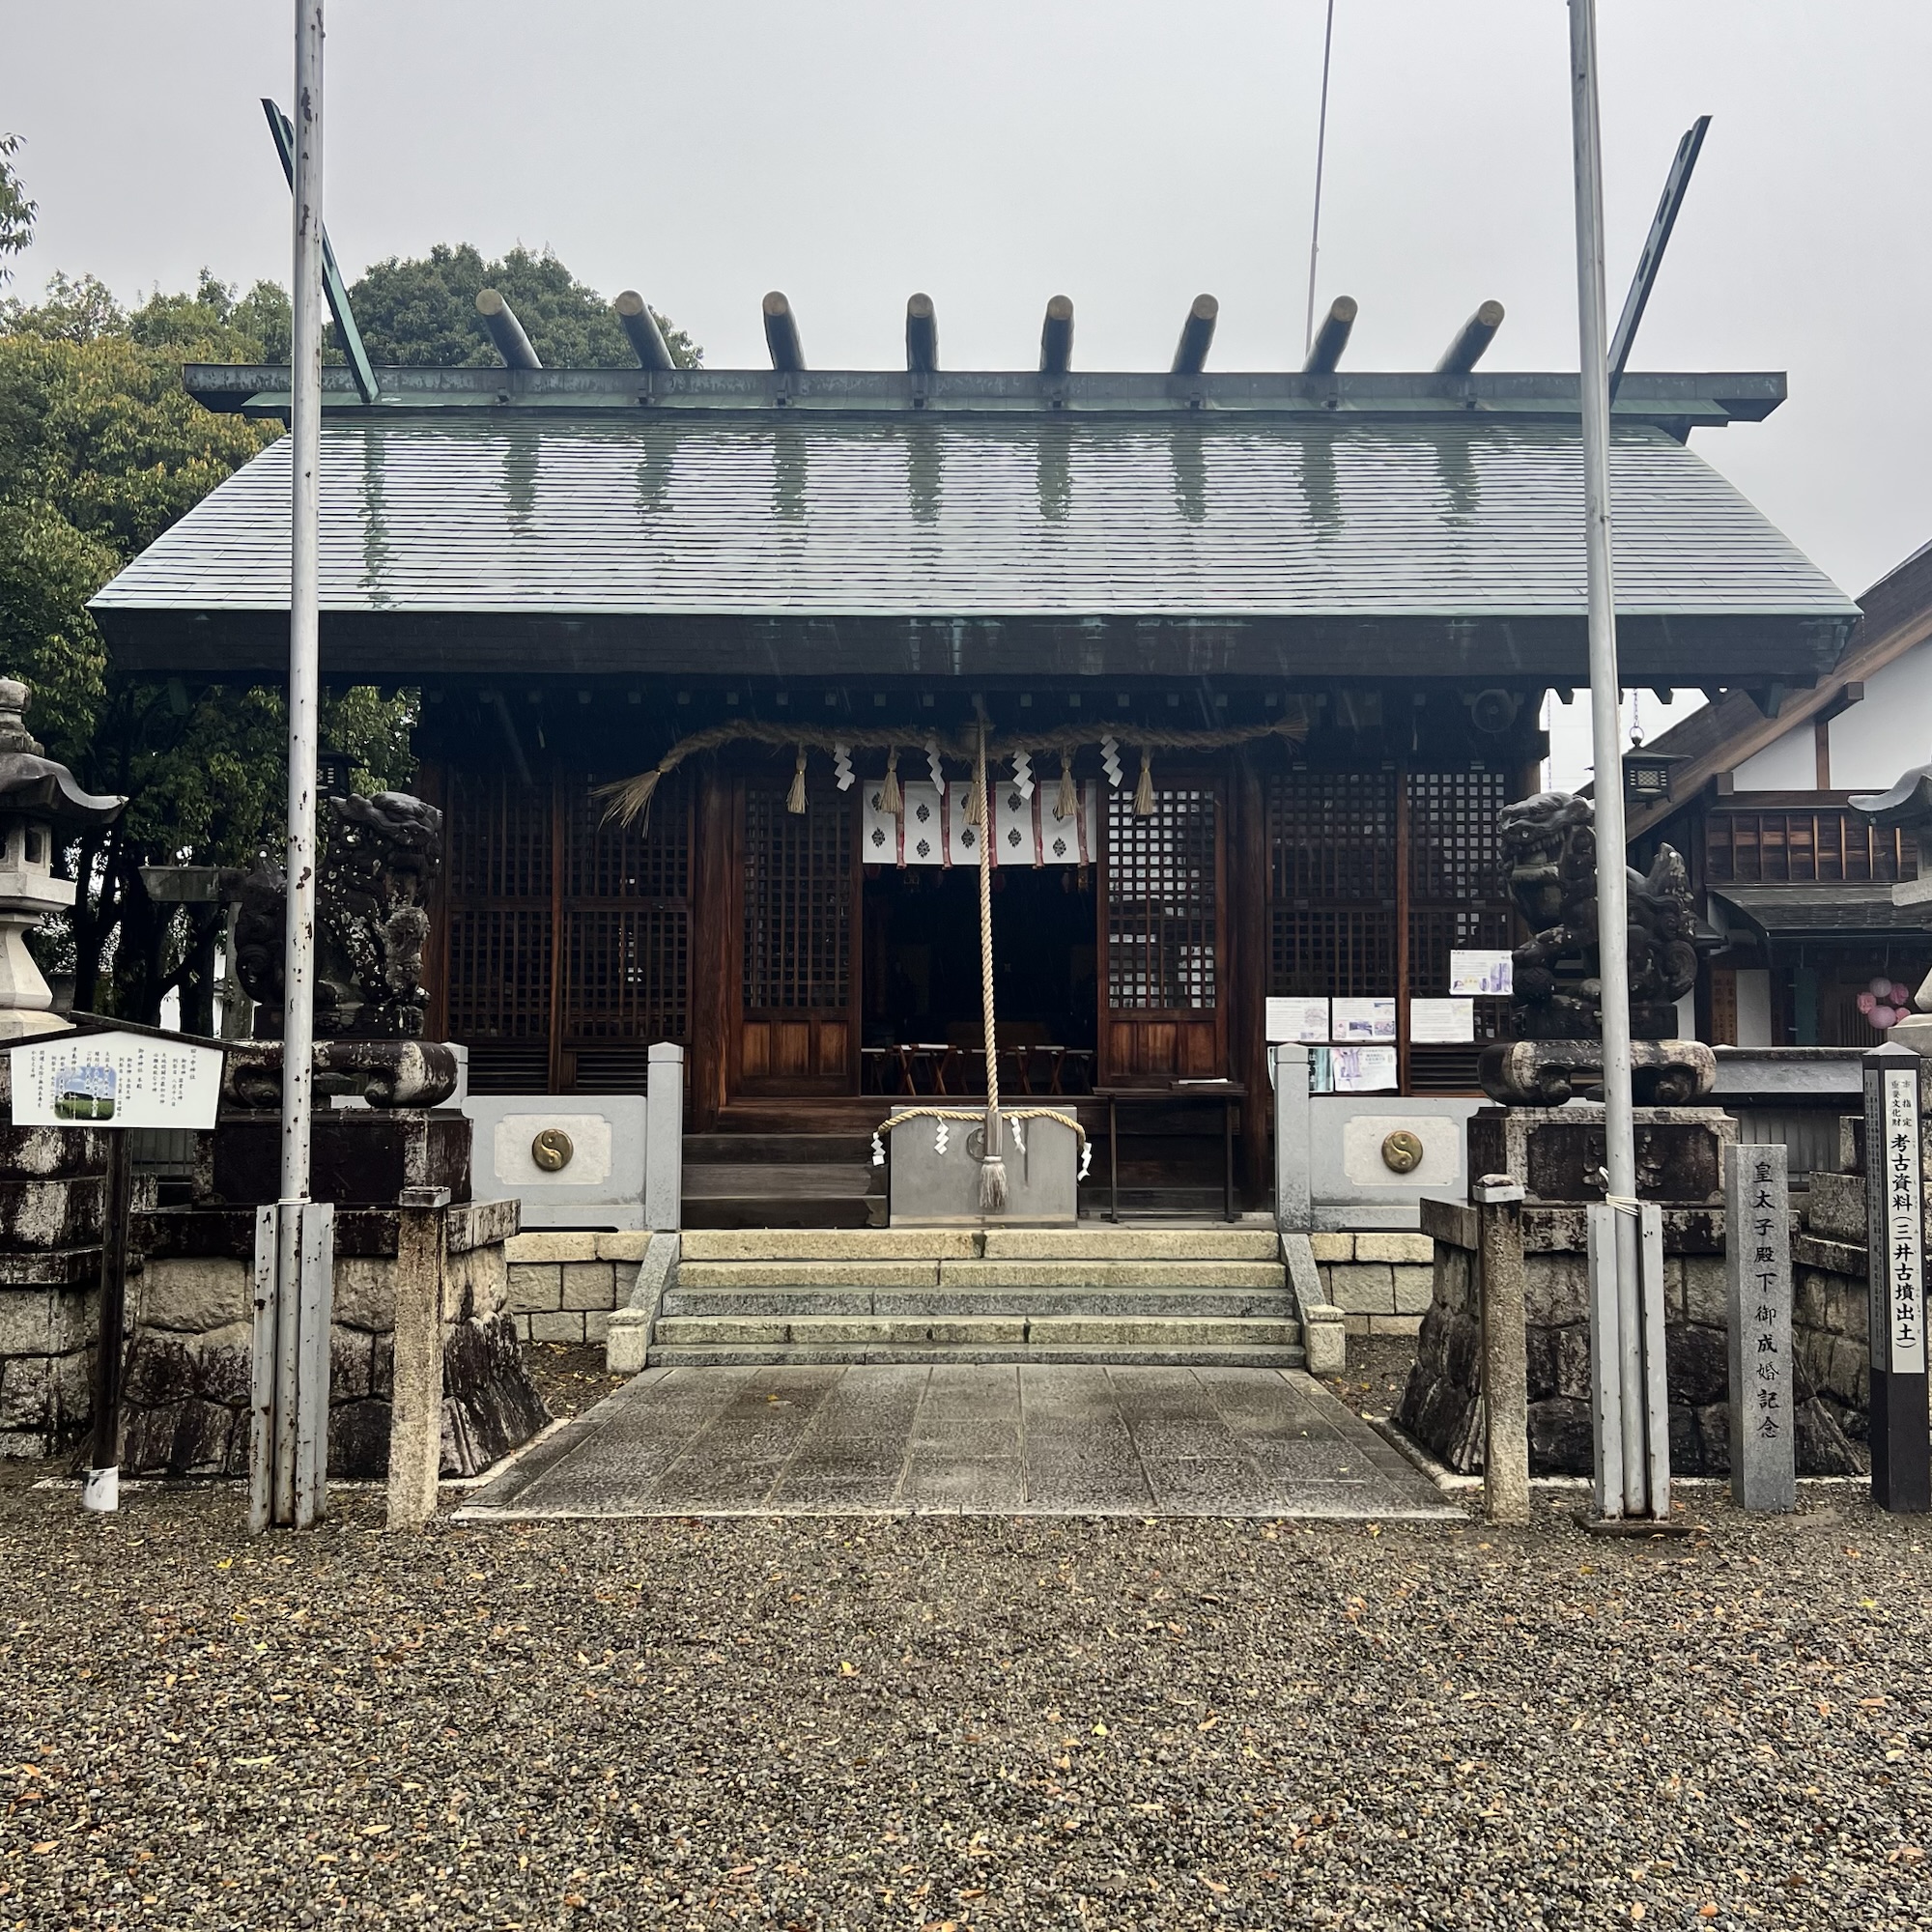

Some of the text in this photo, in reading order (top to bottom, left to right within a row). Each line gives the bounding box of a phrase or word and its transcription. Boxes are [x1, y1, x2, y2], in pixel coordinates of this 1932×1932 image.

[1890, 1080, 1902, 1127] 重要文化財
[1902, 1080, 1913, 1127] 市指定
[1752, 1161, 1780, 1439] 皇太子殿下御成婚記念
